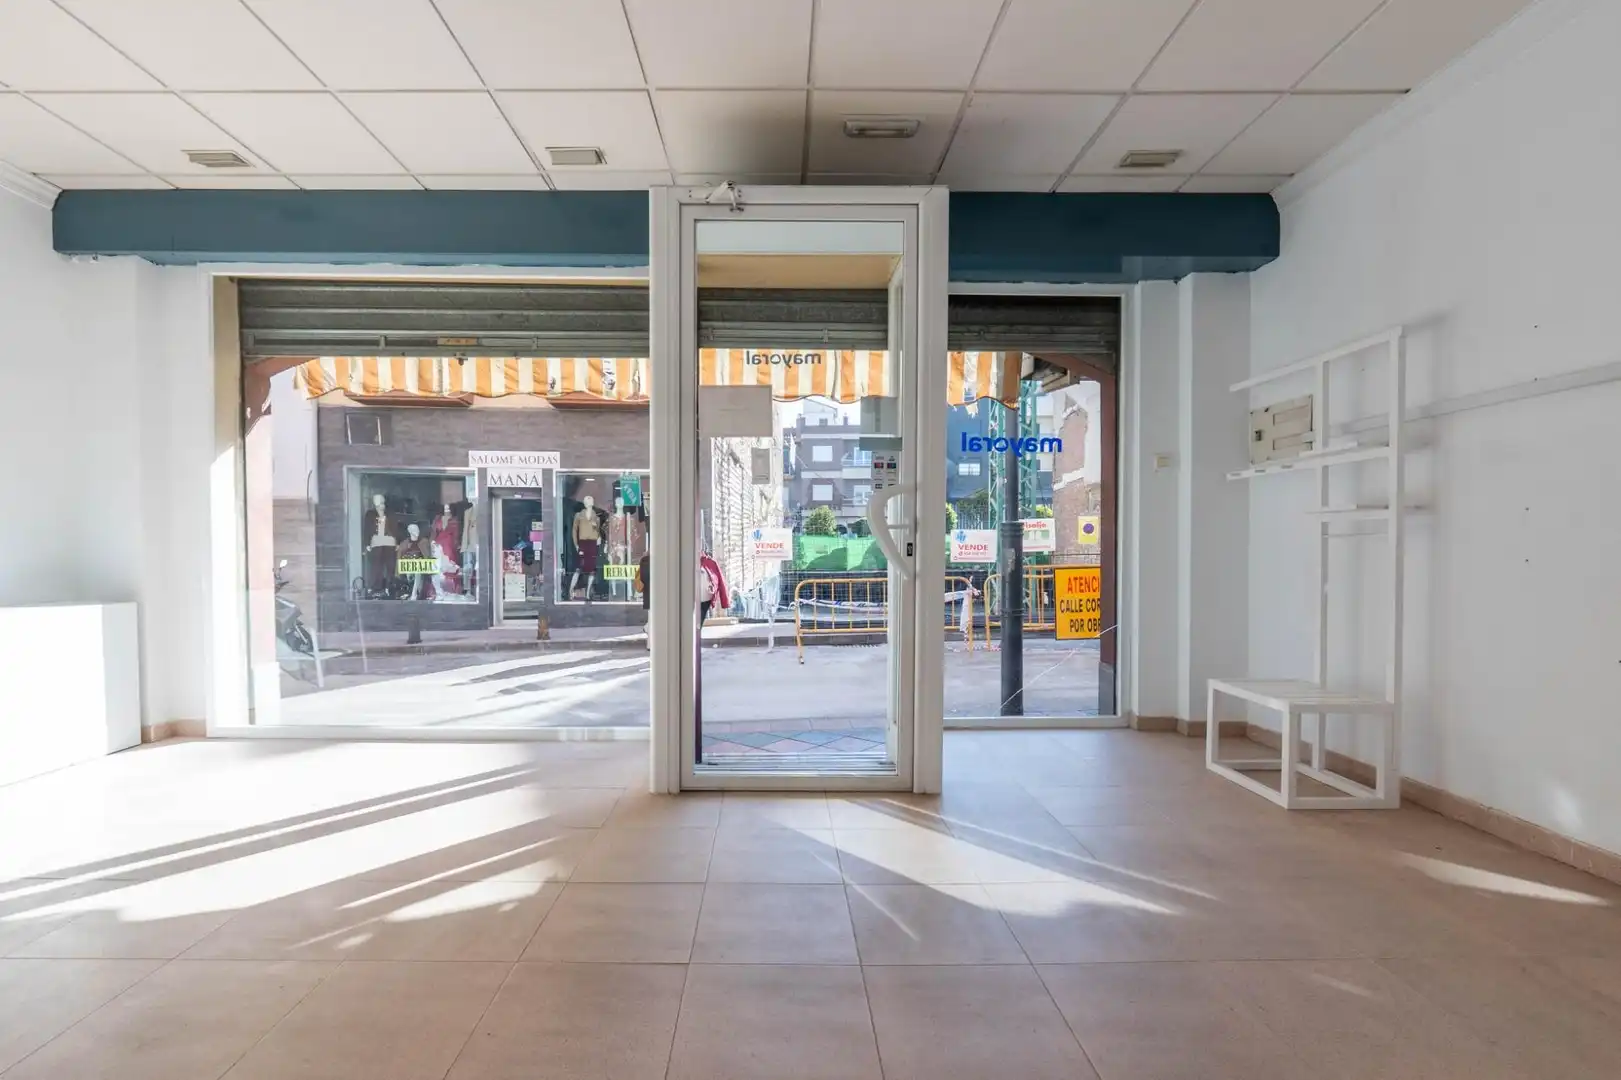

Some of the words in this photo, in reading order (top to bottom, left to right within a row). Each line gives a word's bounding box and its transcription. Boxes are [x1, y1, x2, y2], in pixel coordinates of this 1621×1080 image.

[519, 455, 559, 465] MODAS
[754, 542, 785, 550] VENDE
[958, 544, 989, 552] VENDE
[1060, 599, 1083, 613] CALLE
[1070, 619, 1084, 632] POR
